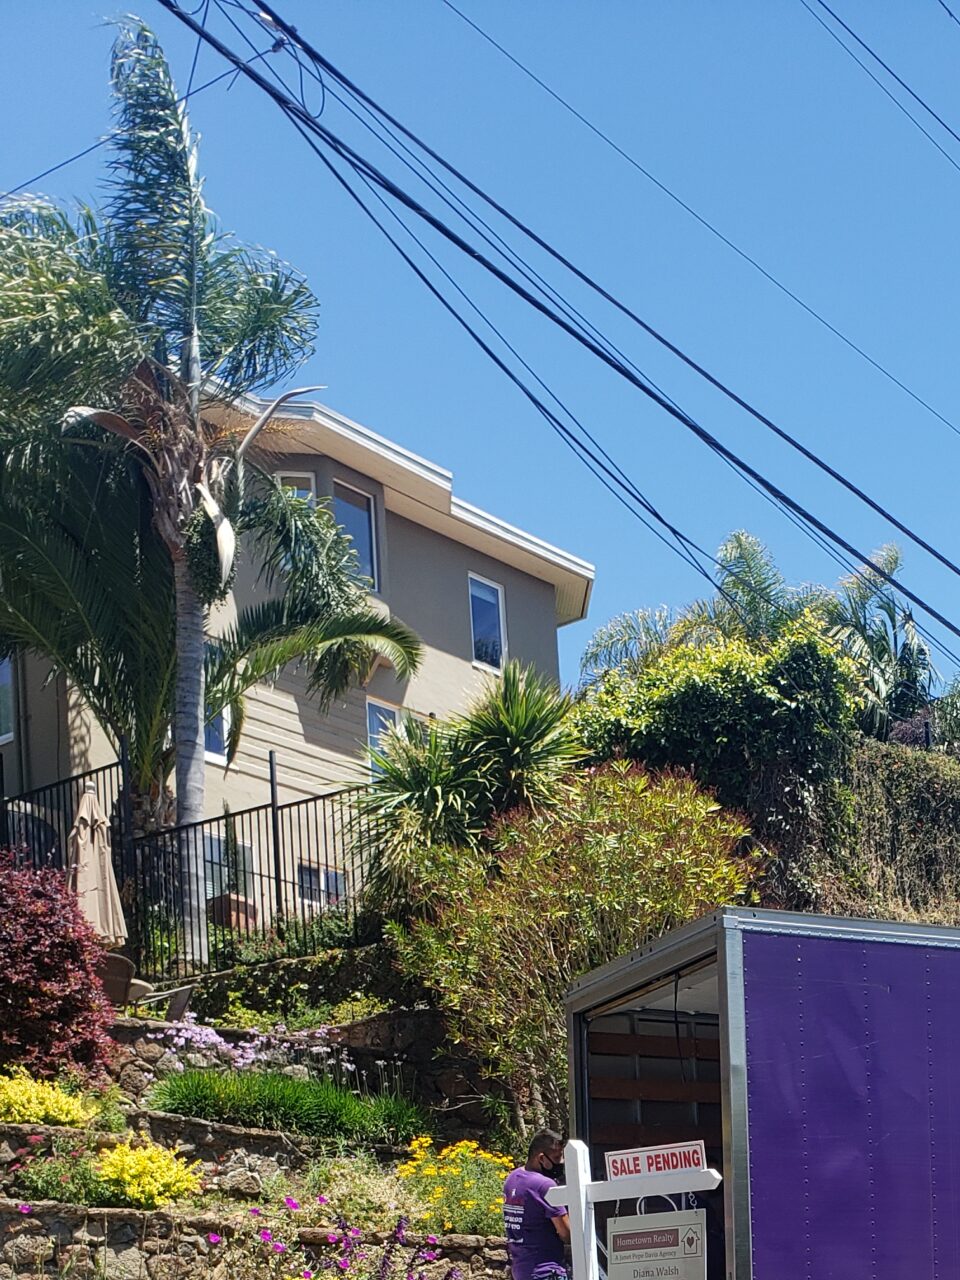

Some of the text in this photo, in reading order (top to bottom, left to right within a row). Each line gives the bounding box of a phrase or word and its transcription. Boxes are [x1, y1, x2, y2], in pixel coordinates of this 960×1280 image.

[611, 1149, 701, 1177] SALE PENDING
[616, 1233, 674, 1247] Hometown Realty
[633, 1266, 679, 1279] Diana Walsh
